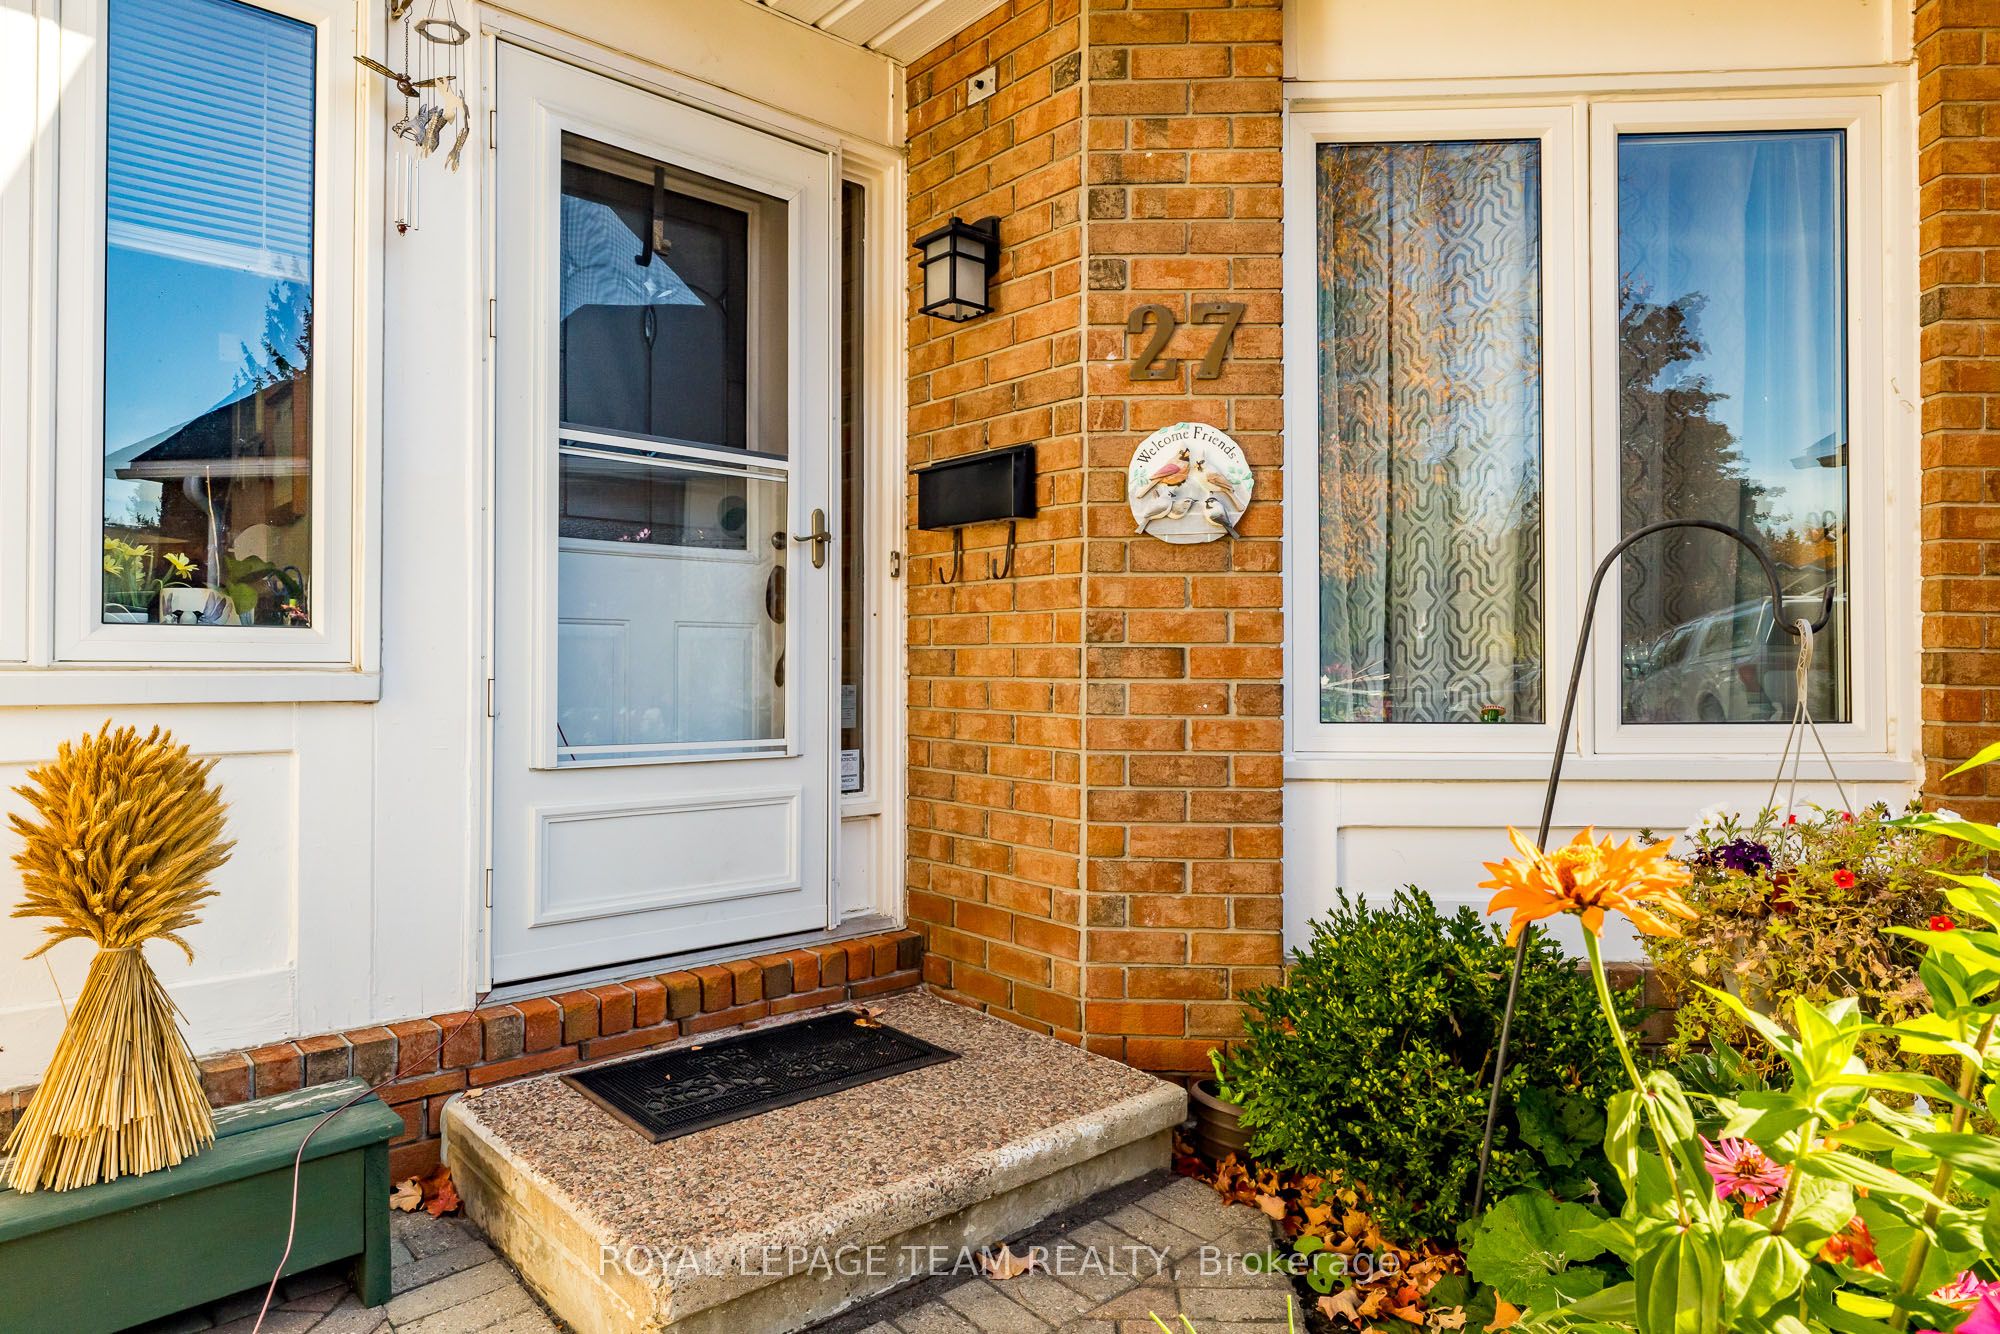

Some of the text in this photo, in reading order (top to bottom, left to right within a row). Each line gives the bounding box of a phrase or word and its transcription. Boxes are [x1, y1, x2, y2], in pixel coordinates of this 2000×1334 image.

[1127, 302, 1245, 380] 27
[1136, 426, 1237, 464] Welcome Friends
